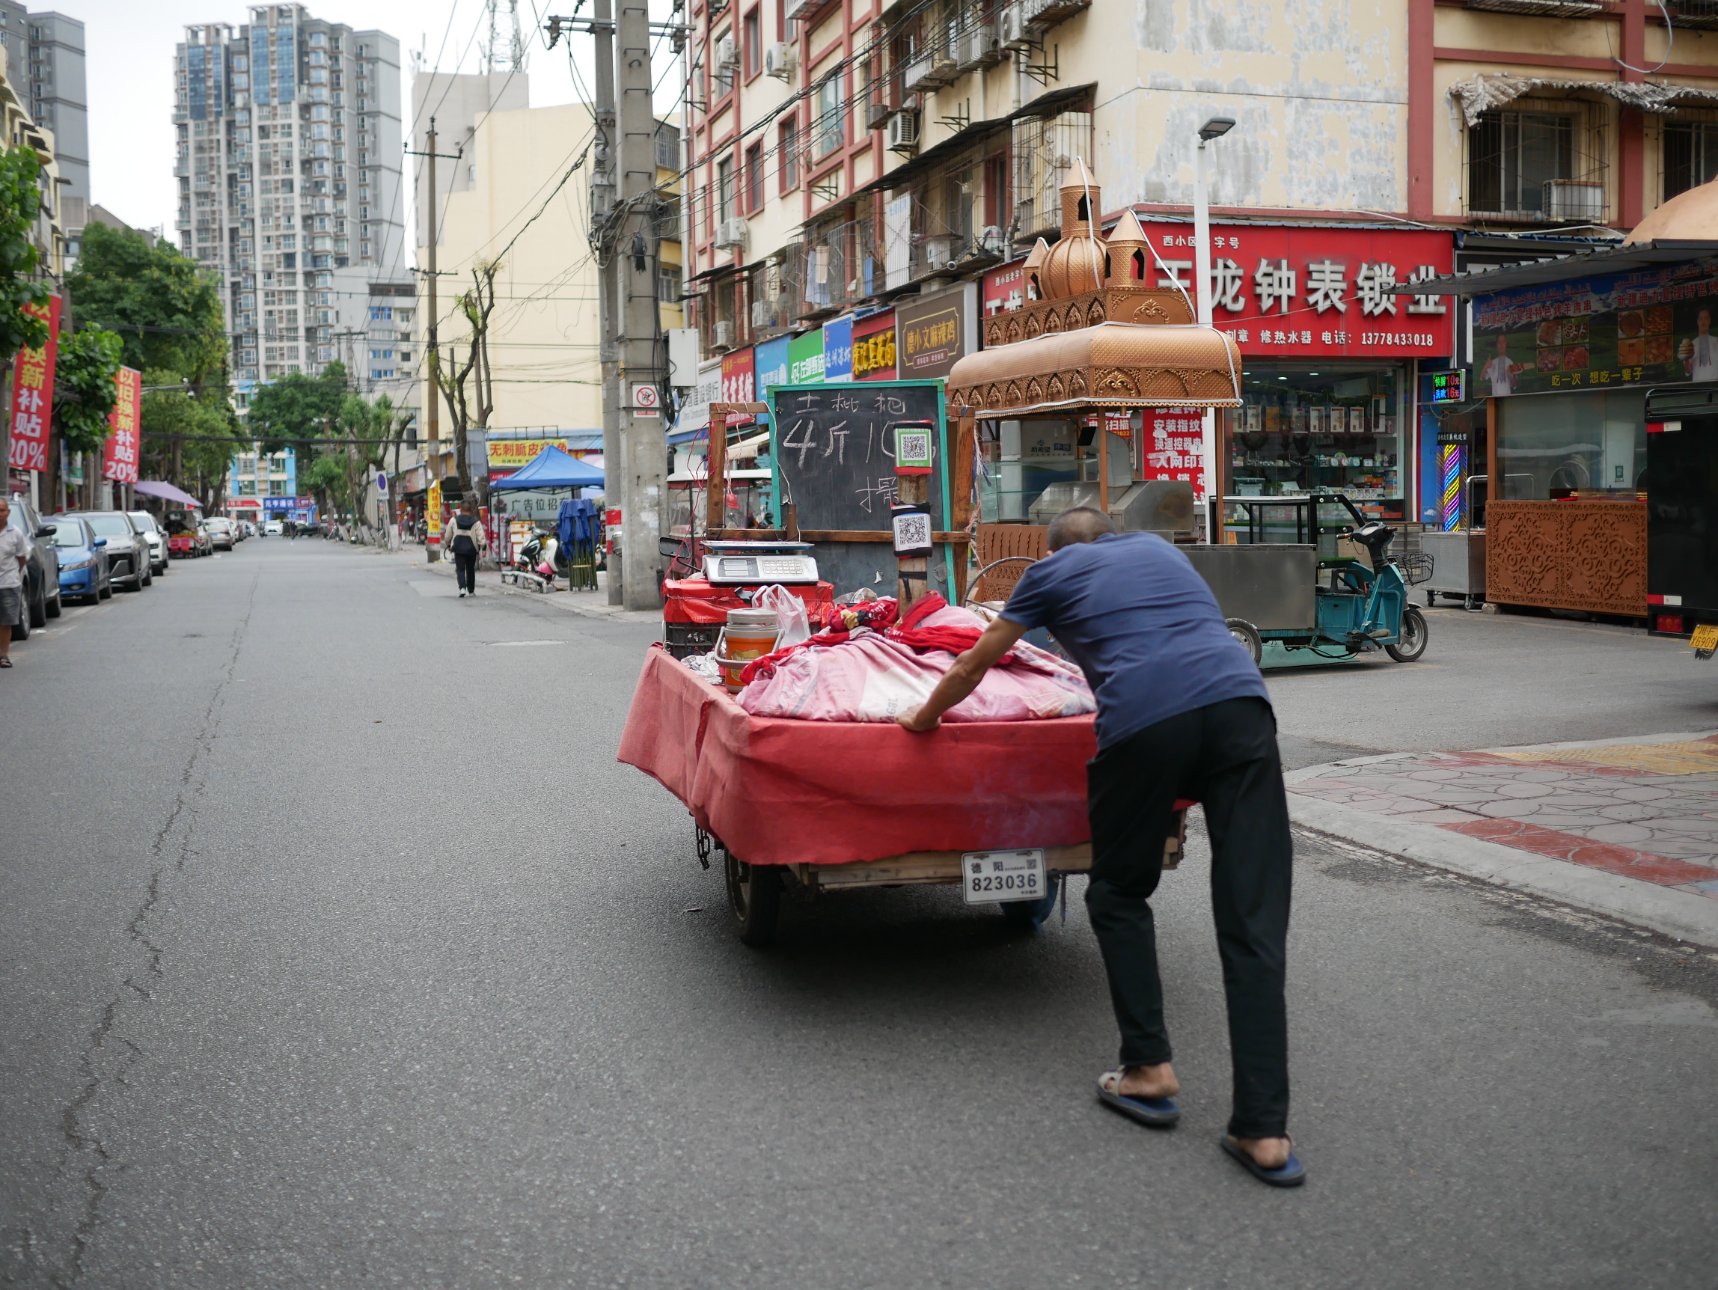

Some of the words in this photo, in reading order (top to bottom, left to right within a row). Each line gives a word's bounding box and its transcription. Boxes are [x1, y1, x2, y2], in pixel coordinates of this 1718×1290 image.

[1163, 235, 1239, 249] 西小区字号
[995, 268, 1024, 286] 西小区老字
[1260, 330, 1312, 344] 修热水器
[1362, 333, 1433, 346] 13778433018
[1551, 373, 1581, 386] 吃一次
[1589, 368, 1643, 384] 想吃一辈子
[1154, 419, 1202, 433] 安装指纹
[105, 462, 138, 482] 20%
[512, 498, 567, 512] 广告位招
[972, 873, 1037, 892] 823036
